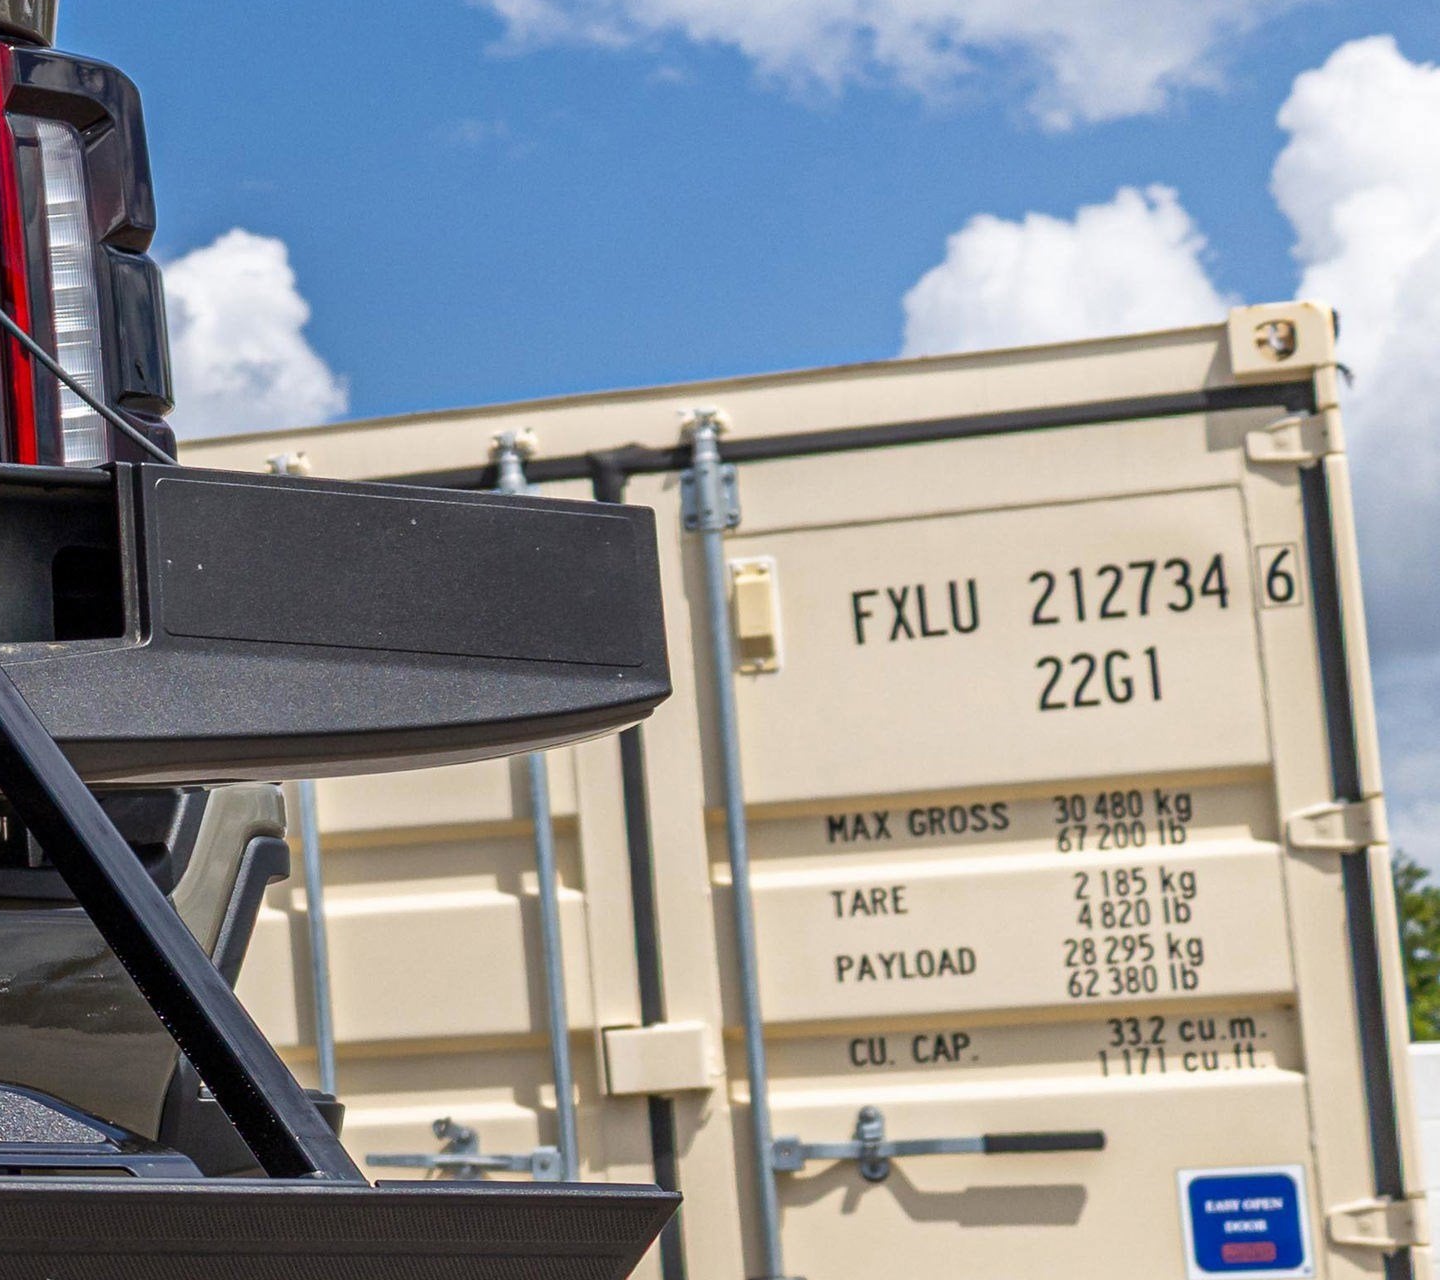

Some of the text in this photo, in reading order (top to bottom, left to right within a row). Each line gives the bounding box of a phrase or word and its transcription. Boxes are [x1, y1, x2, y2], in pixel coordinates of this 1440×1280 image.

[850, 548, 1296, 645] FXLU 212734 6
[1035, 646, 1162, 711] 22G1
[827, 811, 892, 844] MAX
[907, 802, 1010, 837] GROSS
[1154, 788, 1193, 822] kg
[1158, 818, 1187, 846] lb
[830, 885, 908, 918] TARE
[1159, 866, 1197, 899] kg
[1162, 896, 1192, 923] lb
[835, 946, 978, 984] PAYLOAD
[1166, 932, 1204, 966] kg
[1170, 963, 1199, 991] lb
[849, 1036, 896, 1067] CU.
[911, 1031, 980, 1064] CAP.
